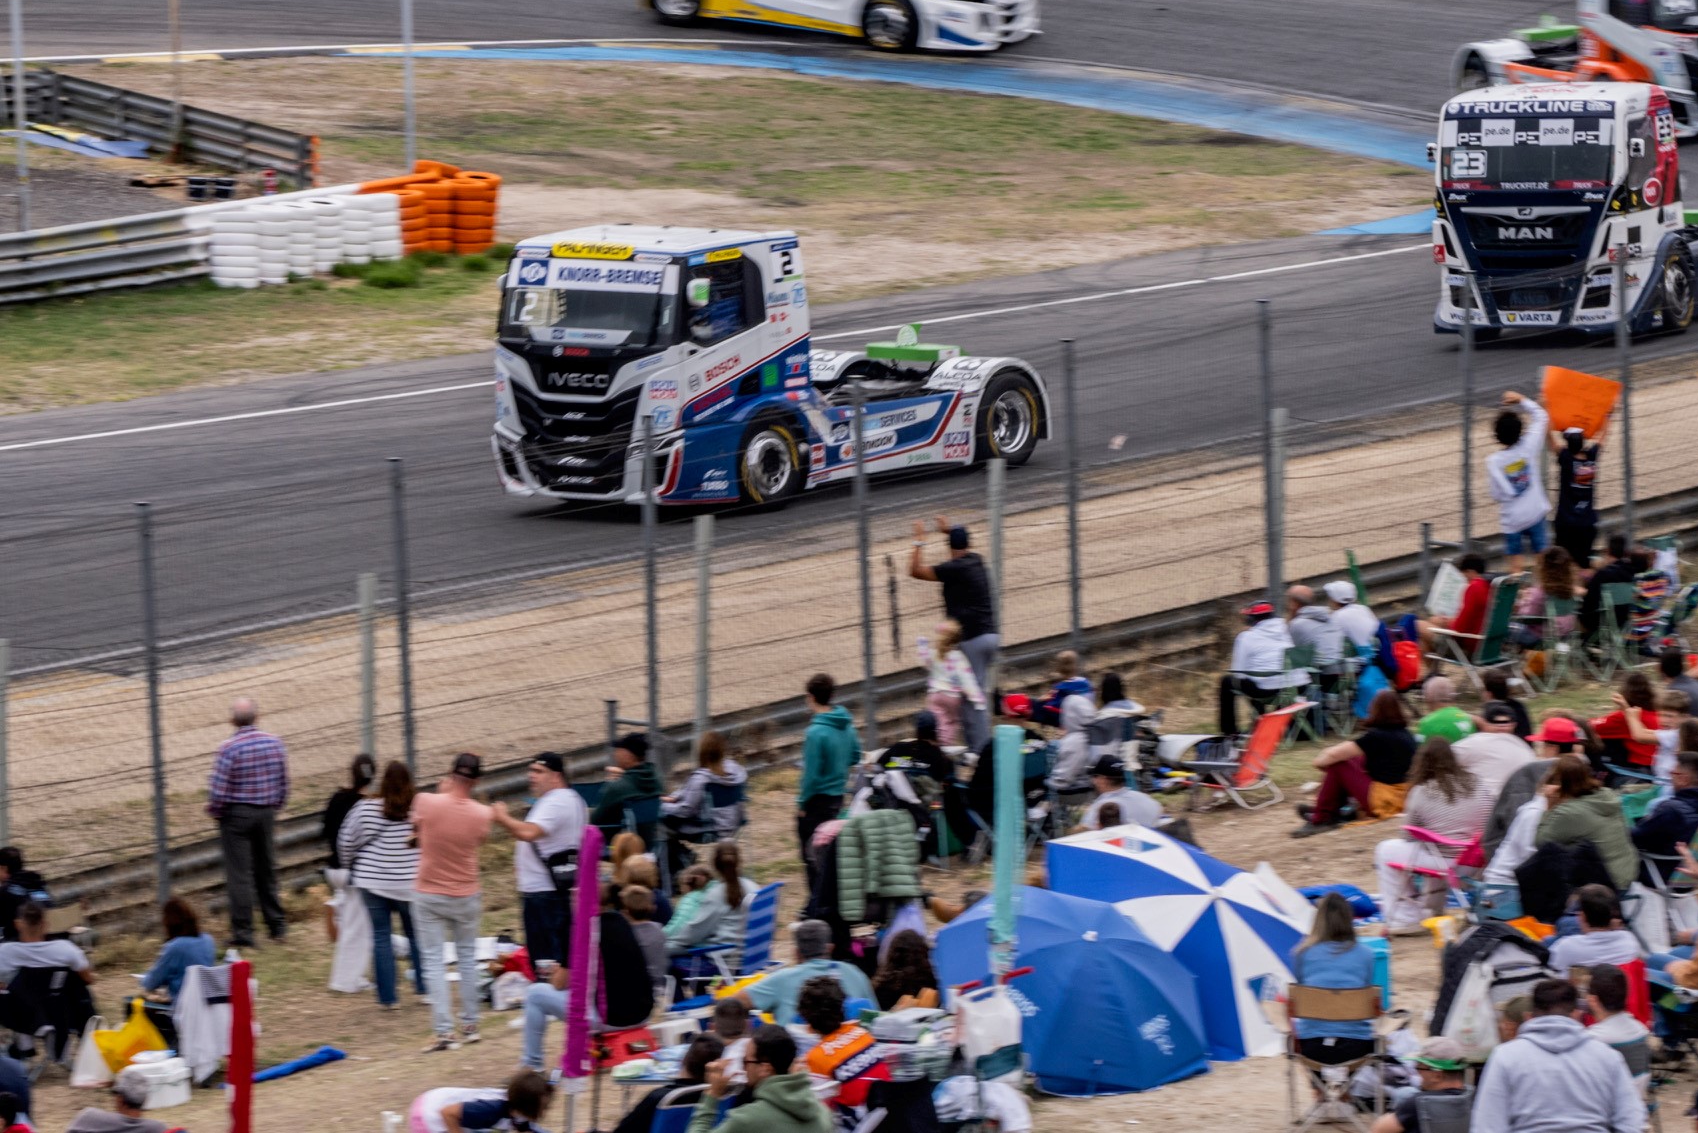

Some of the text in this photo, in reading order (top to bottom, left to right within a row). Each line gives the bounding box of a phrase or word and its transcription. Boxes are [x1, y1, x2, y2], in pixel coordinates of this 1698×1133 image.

[1461, 100, 1584, 114] TRUCKLINE
[1485, 125, 1570, 137] pe.de pe.de
[1453, 153, 1486, 176] 23
[1498, 226, 1554, 240] MAN
[781, 251, 793, 275] 2
[556, 267, 663, 285] KNORR-BREMSE
[518, 292, 539, 323] 2
[1519, 312, 1553, 322] VARTA
[705, 355, 741, 382] BOSCH
[547, 372, 609, 388] IVECO
